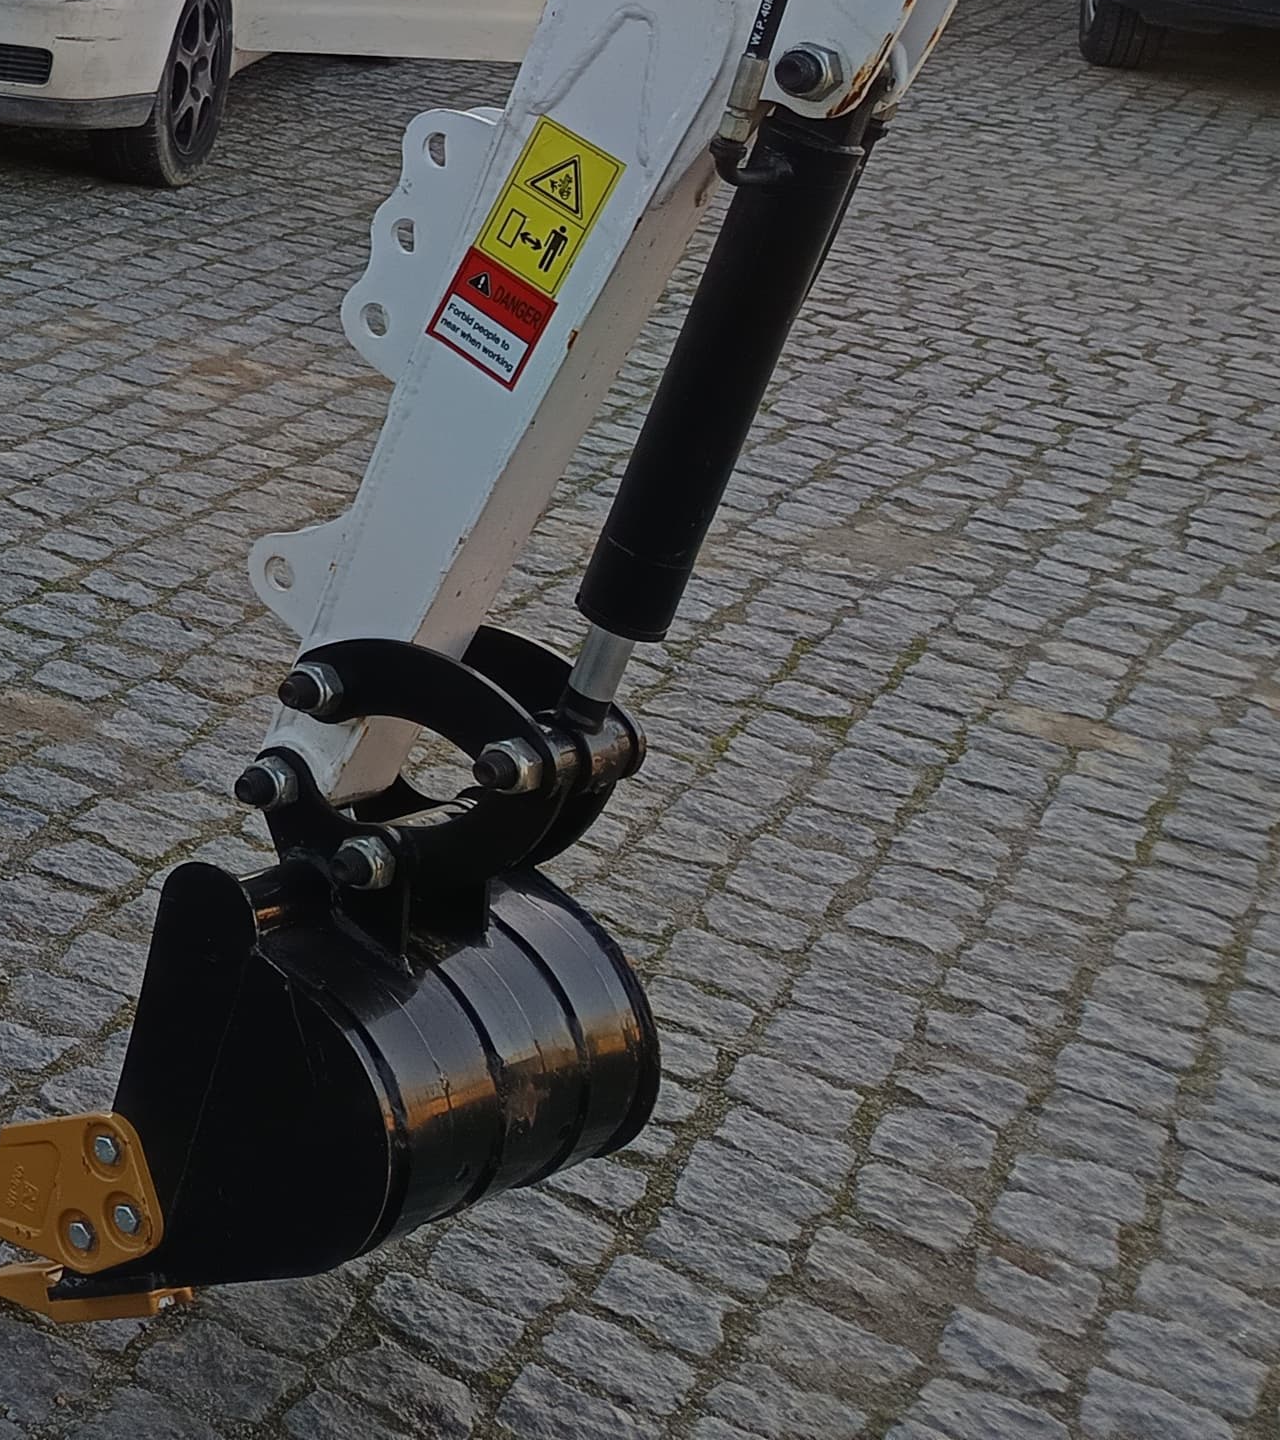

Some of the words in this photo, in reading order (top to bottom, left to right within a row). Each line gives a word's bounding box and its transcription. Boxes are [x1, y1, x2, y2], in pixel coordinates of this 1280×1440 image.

[447, 302, 474, 326] Forbid
[473, 320, 501, 346] people
[501, 339, 510, 351] to
[492, 285, 542, 329] DANGER
[440, 317, 460, 333] near
[460, 328, 482, 350] when
[481, 344, 514, 373] working
